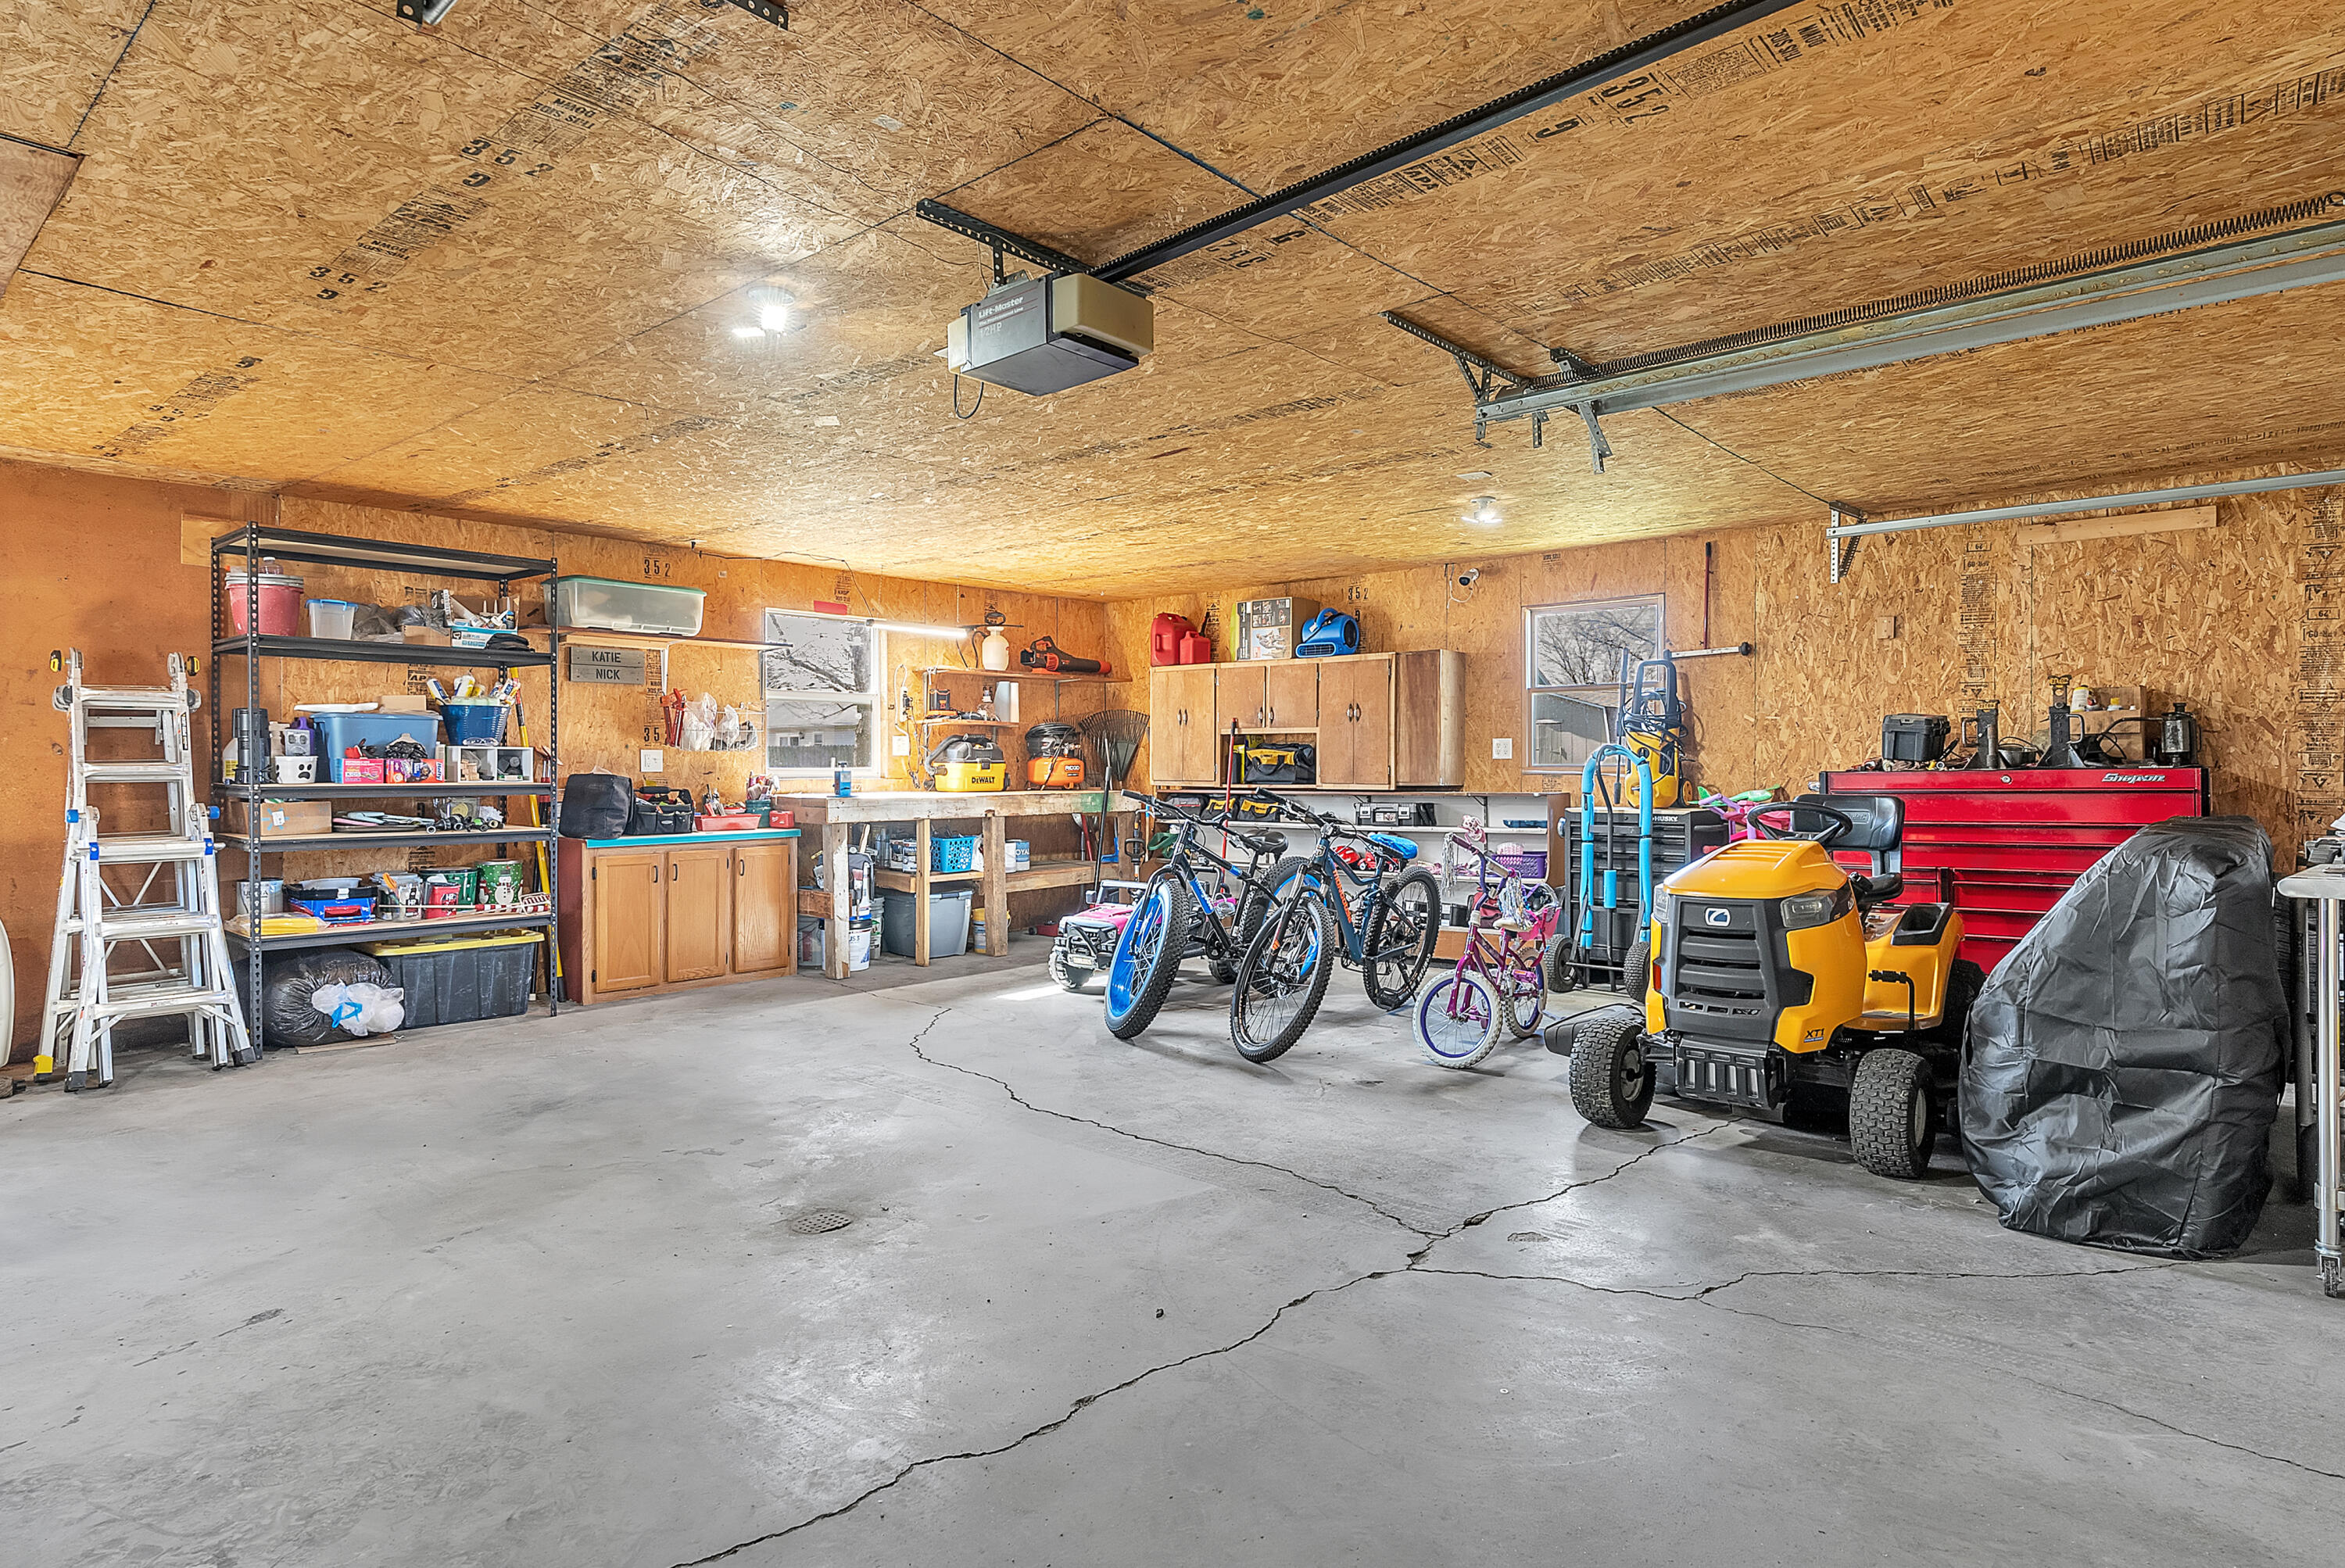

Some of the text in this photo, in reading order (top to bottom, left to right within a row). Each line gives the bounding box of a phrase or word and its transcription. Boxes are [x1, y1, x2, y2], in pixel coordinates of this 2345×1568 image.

[1767, 27, 1803, 63] THIS SIDE
[1798, 23, 1827, 48] DOWN
[530, 101, 596, 130] THIS SIDE
[553, 98, 597, 118] DOWN
[371, 240, 410, 252] DOWN
[978, 296, 1024, 318] Lift-Master
[644, 558, 671, 578] 352
[1348, 586, 1369, 601] 352
[592, 650, 621, 663] KATIE
[596, 668, 621, 680] NICK
[1805, 1028, 1825, 1038] XT1
